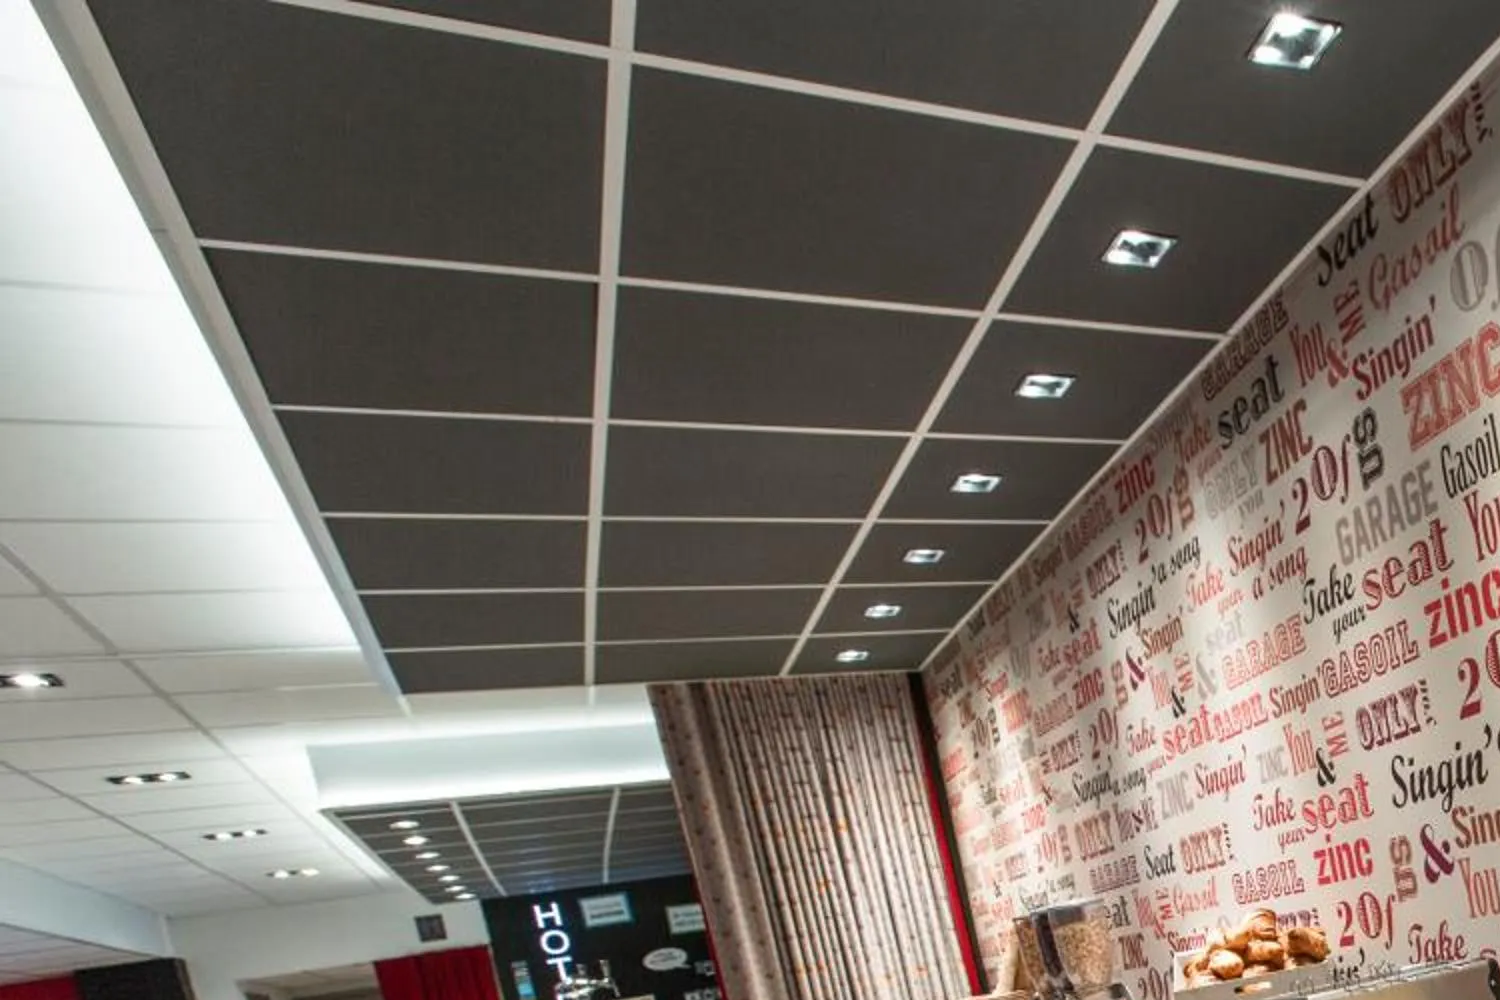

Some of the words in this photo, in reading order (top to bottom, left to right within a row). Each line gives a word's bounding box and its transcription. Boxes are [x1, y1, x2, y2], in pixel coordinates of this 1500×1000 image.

[1389, 97, 1473, 224] ONLY
[1367, 181, 1467, 312] Gasoil
[1289, 322, 1328, 388] You
[1218, 354, 1286, 449] seat
[1258, 398, 1313, 486] ZINC
[1114, 453, 1155, 516] zinc
[1335, 459, 1440, 566] GARAGE
[1169, 535, 1201, 576] song
[1268, 546, 1309, 592] song
[1302, 563, 1357, 625] Take
[1332, 602, 1367, 644] your
[1362, 517, 1456, 611] seat
[1221, 614, 1307, 690] GARAGE
[1321, 619, 1421, 698] GASOIL
[1163, 703, 1214, 760] seat
[1283, 722, 1317, 776] You
[1355, 683, 1421, 751] ONLY
[1253, 787, 1297, 832] Take
[1278, 827, 1306, 855] your
[1301, 772, 1375, 835] seat
[1231, 859, 1306, 905] GASOIL
[1312, 833, 1374, 886] zinc
[1419, 823, 1455, 884] &
[1407, 919, 1469, 965] Take
